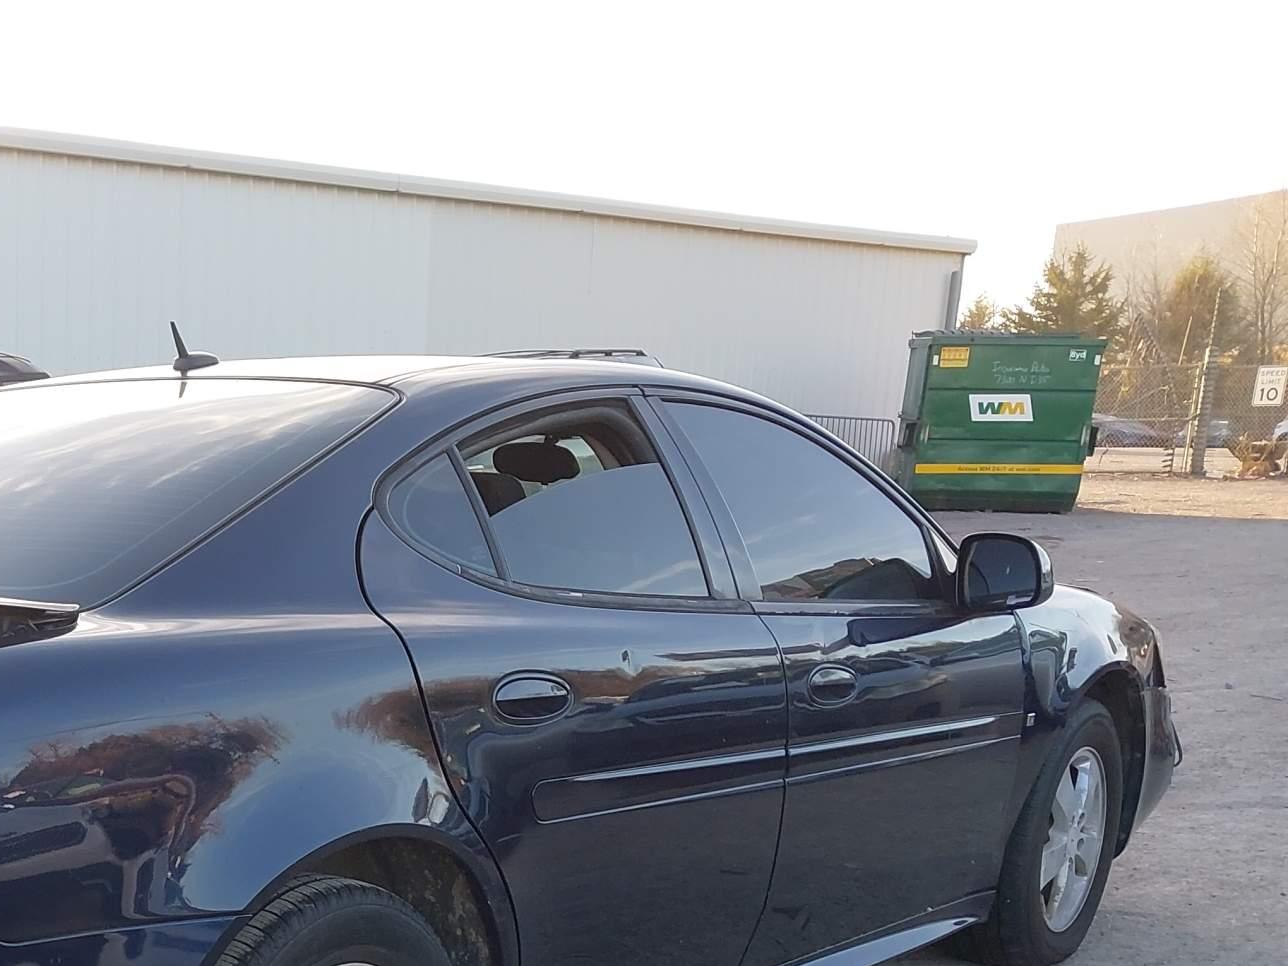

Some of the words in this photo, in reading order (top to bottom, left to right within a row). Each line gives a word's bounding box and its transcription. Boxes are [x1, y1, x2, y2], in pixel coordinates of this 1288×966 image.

[1261, 369, 1286, 377] SPEED
[1259, 387, 1279, 402] 10
[978, 401, 1025, 415] WM
